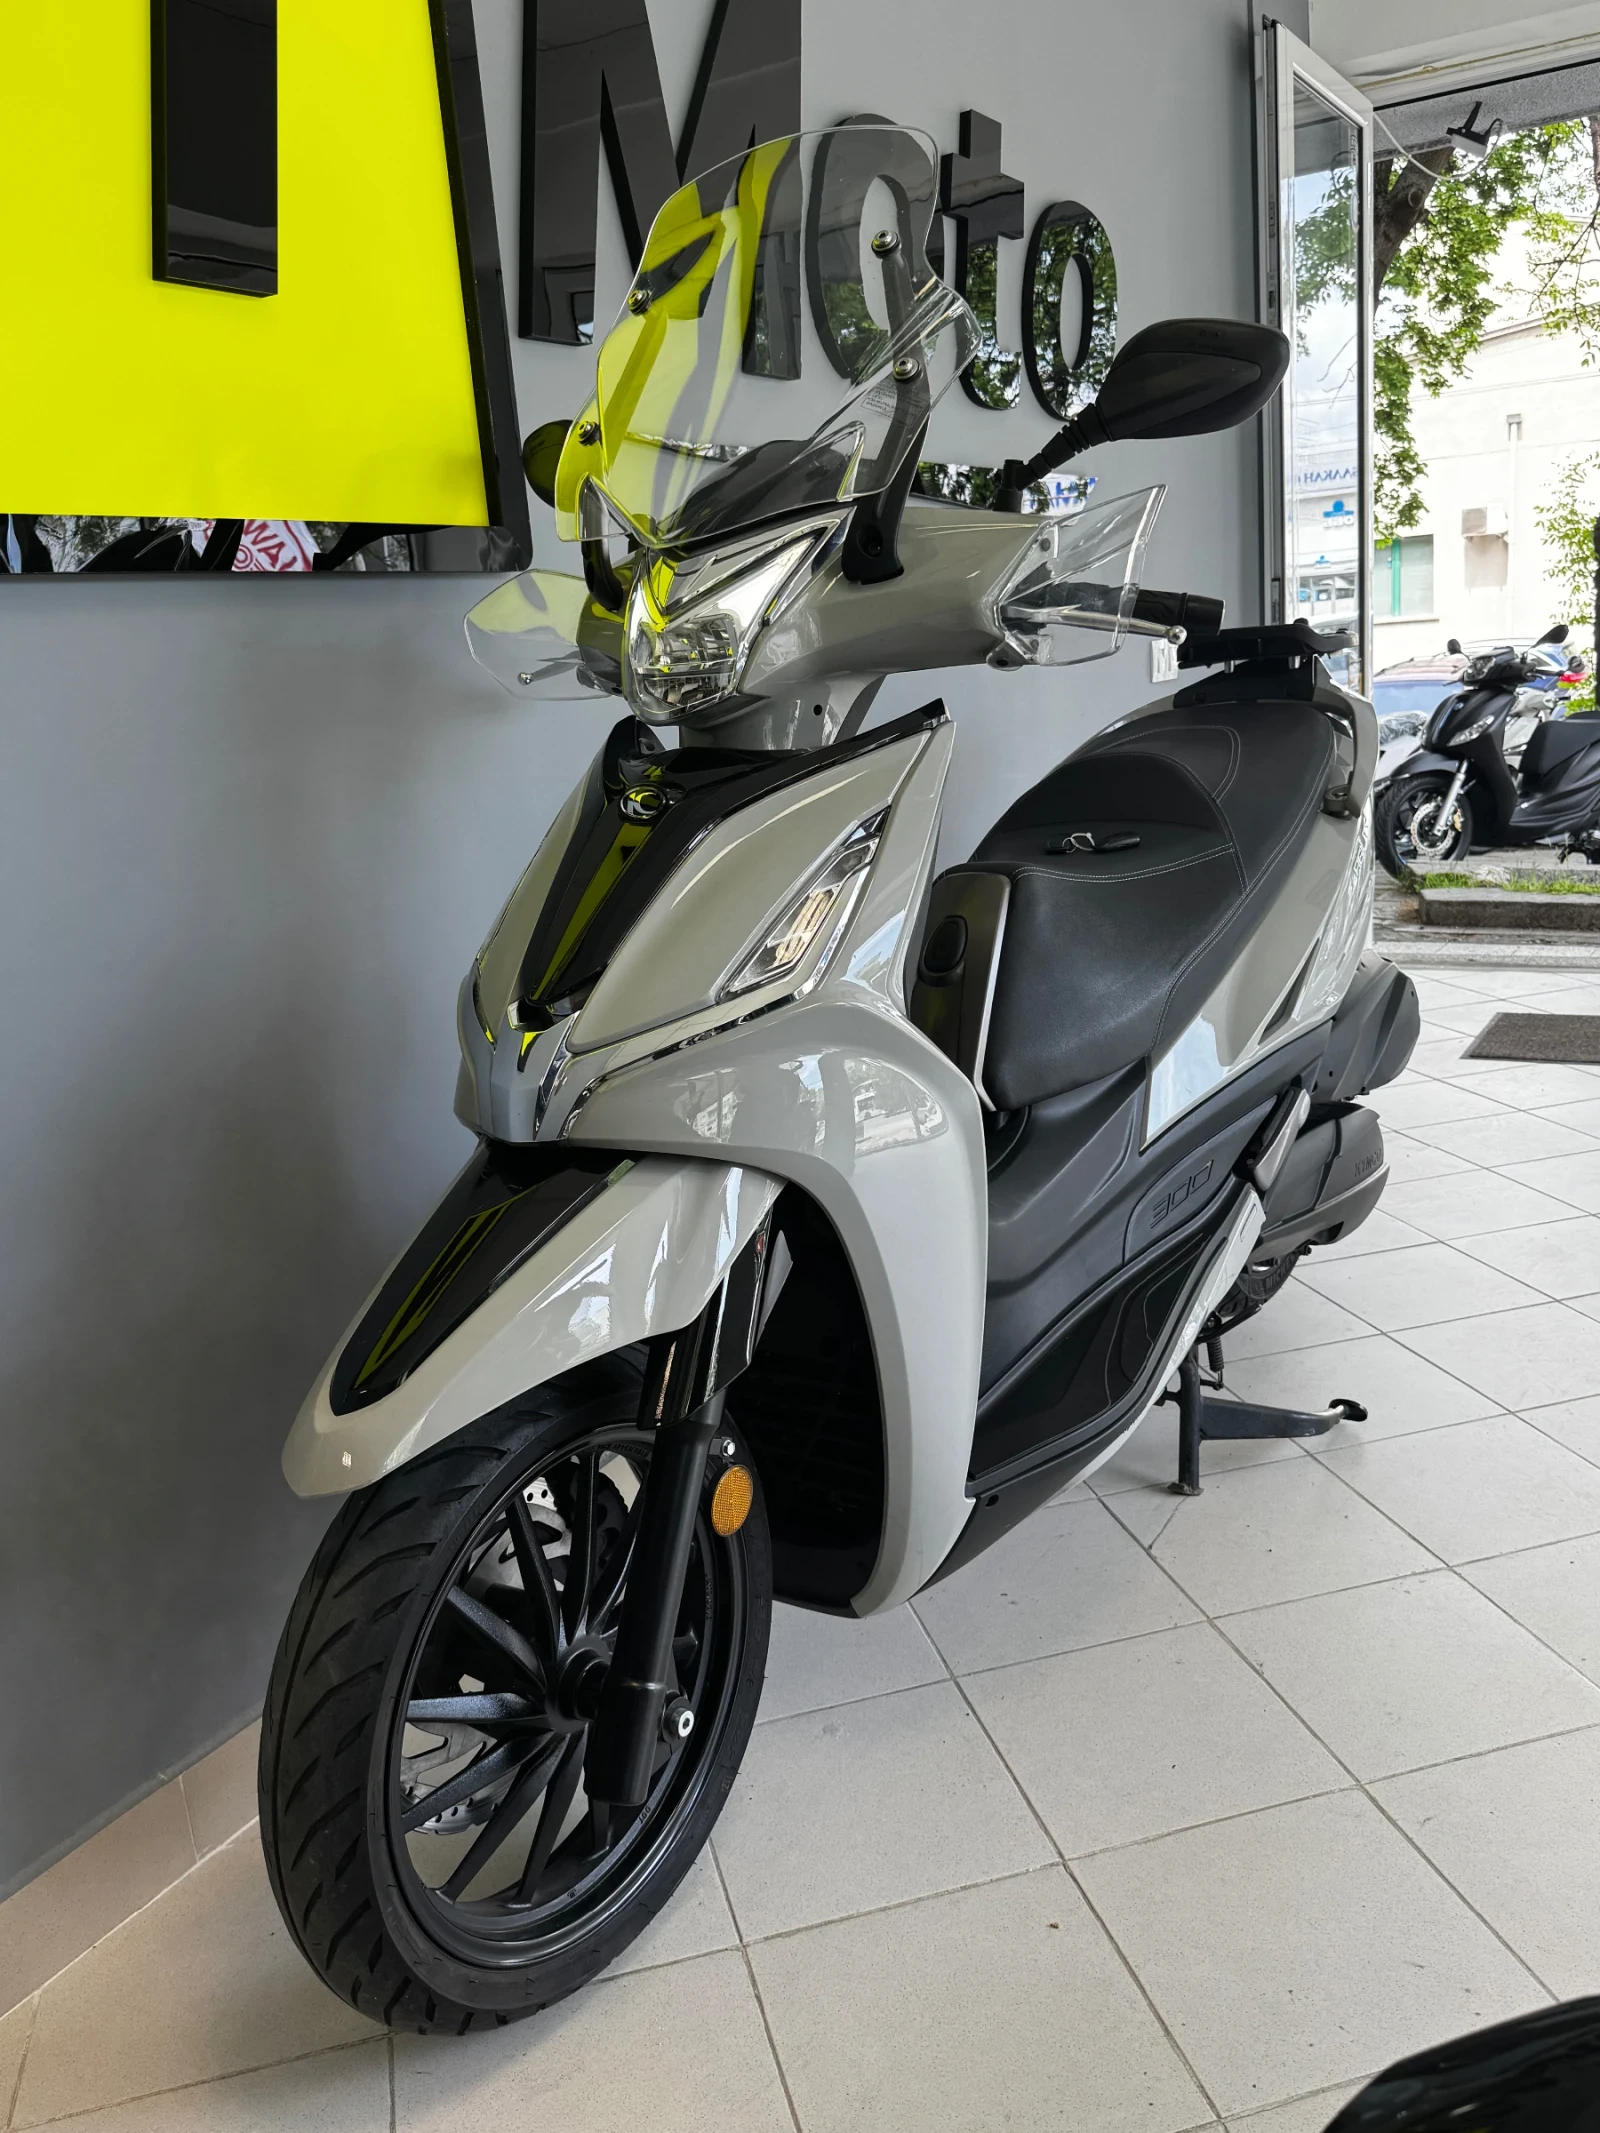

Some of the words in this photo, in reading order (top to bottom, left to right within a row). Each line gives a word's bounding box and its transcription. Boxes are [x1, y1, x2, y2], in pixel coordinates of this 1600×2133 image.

[519, 0, 1118, 421] Moto
[1150, 1158, 1214, 1229] 300
[1354, 1147, 1383, 1178] KYMCO
